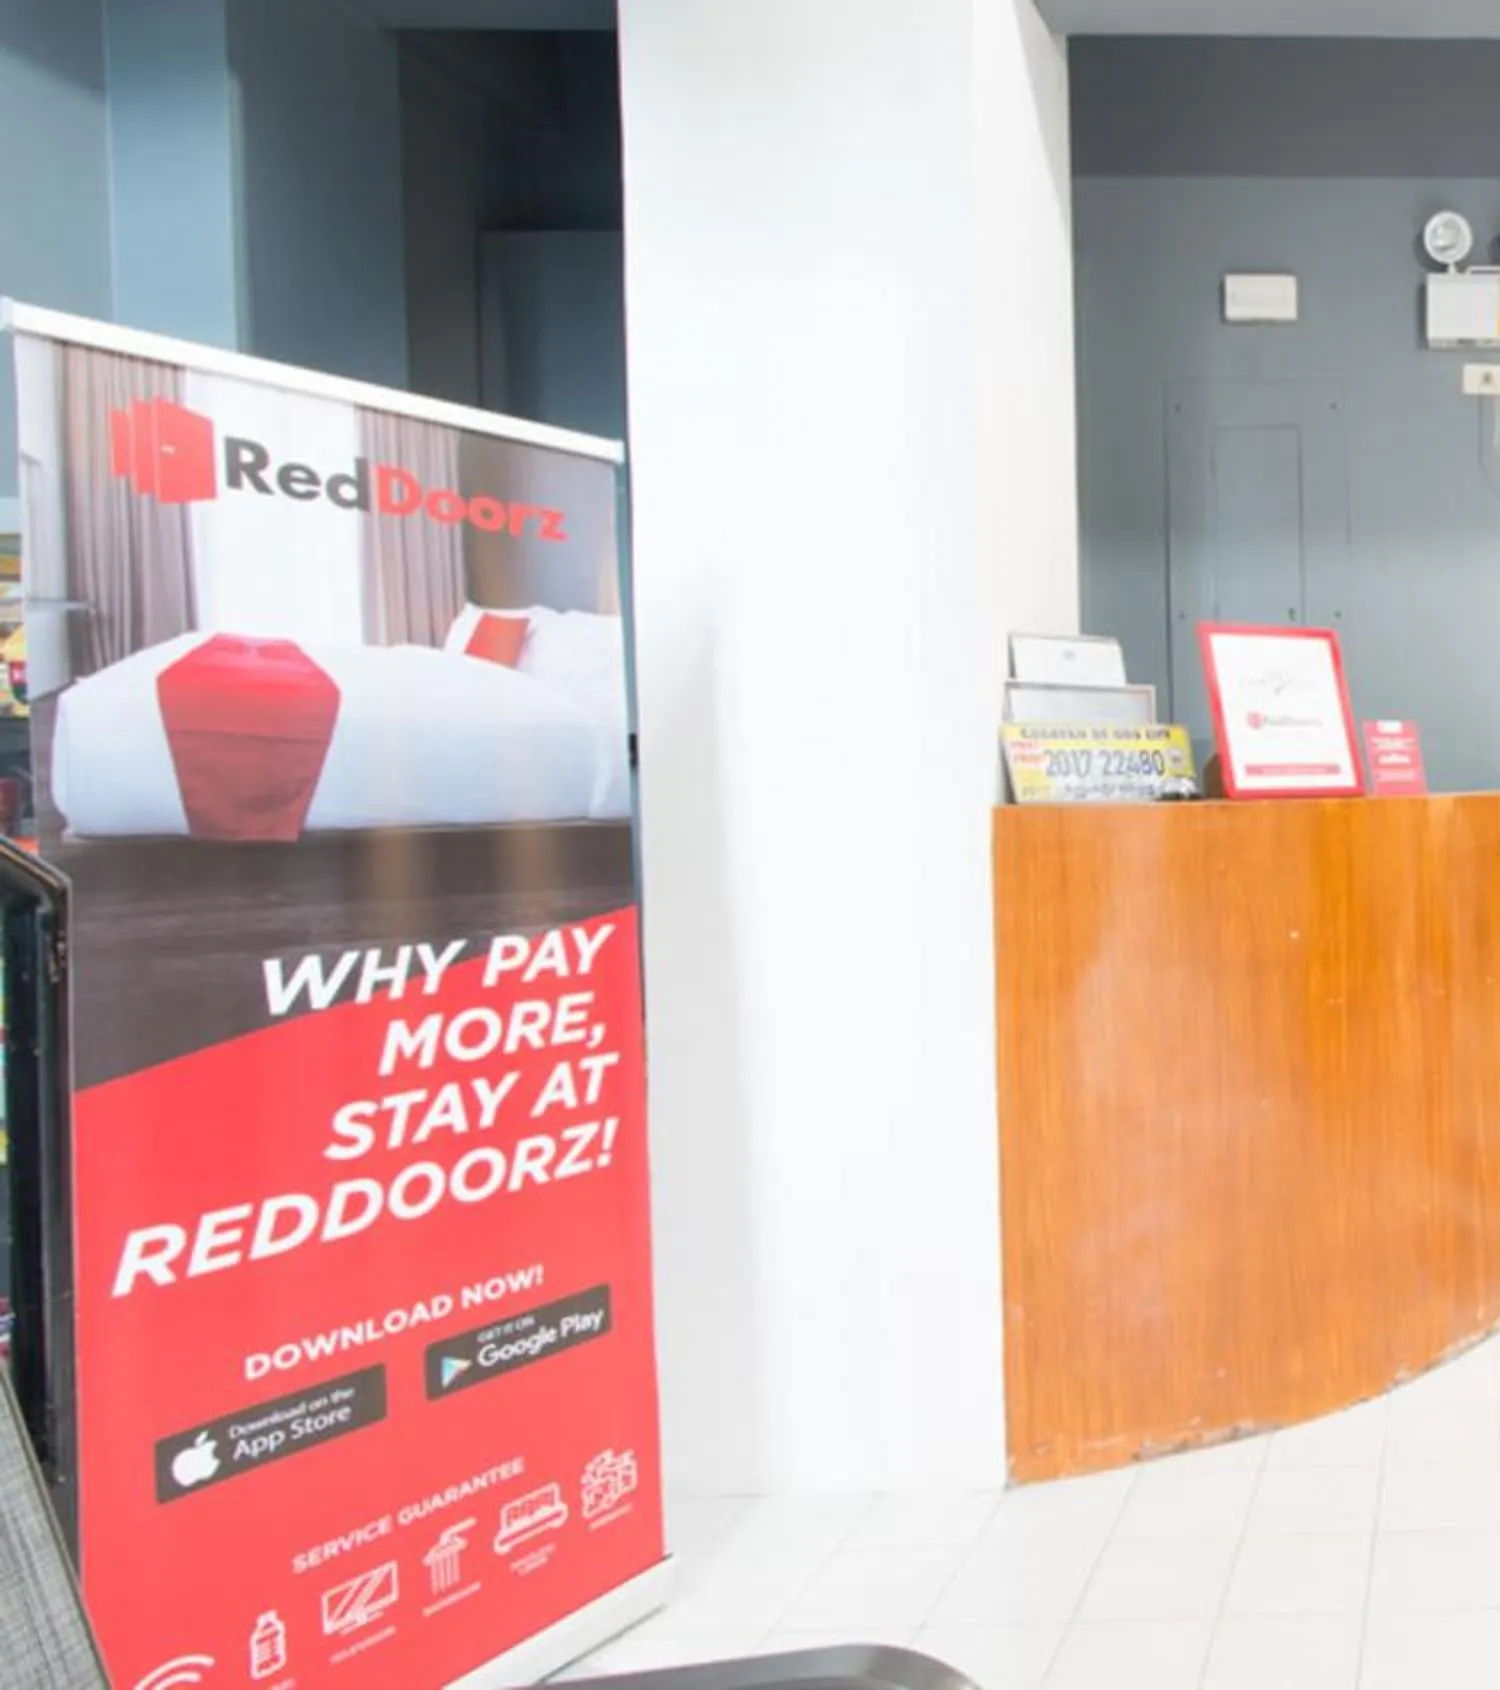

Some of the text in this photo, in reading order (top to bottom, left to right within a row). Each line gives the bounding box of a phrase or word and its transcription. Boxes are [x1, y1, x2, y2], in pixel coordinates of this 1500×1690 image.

[223, 435, 569, 542] RedDoorz
[1044, 749, 1166, 778] 2017 22480
[262, 924, 614, 1016] WHY PAY
[379, 991, 606, 1076] MORE,
[324, 1052, 620, 1160] STAY AT
[111, 1117, 619, 1297] REDDOORZ!
[245, 1265, 544, 1380] DOWNLOAD NOW!
[477, 1308, 604, 1367] Google Play
[229, 1401, 307, 1440] Download
[233, 1406, 352, 1461] App Store
[292, 1514, 392, 1574] SERVICE
[397, 1456, 525, 1526] GUARANTEE
